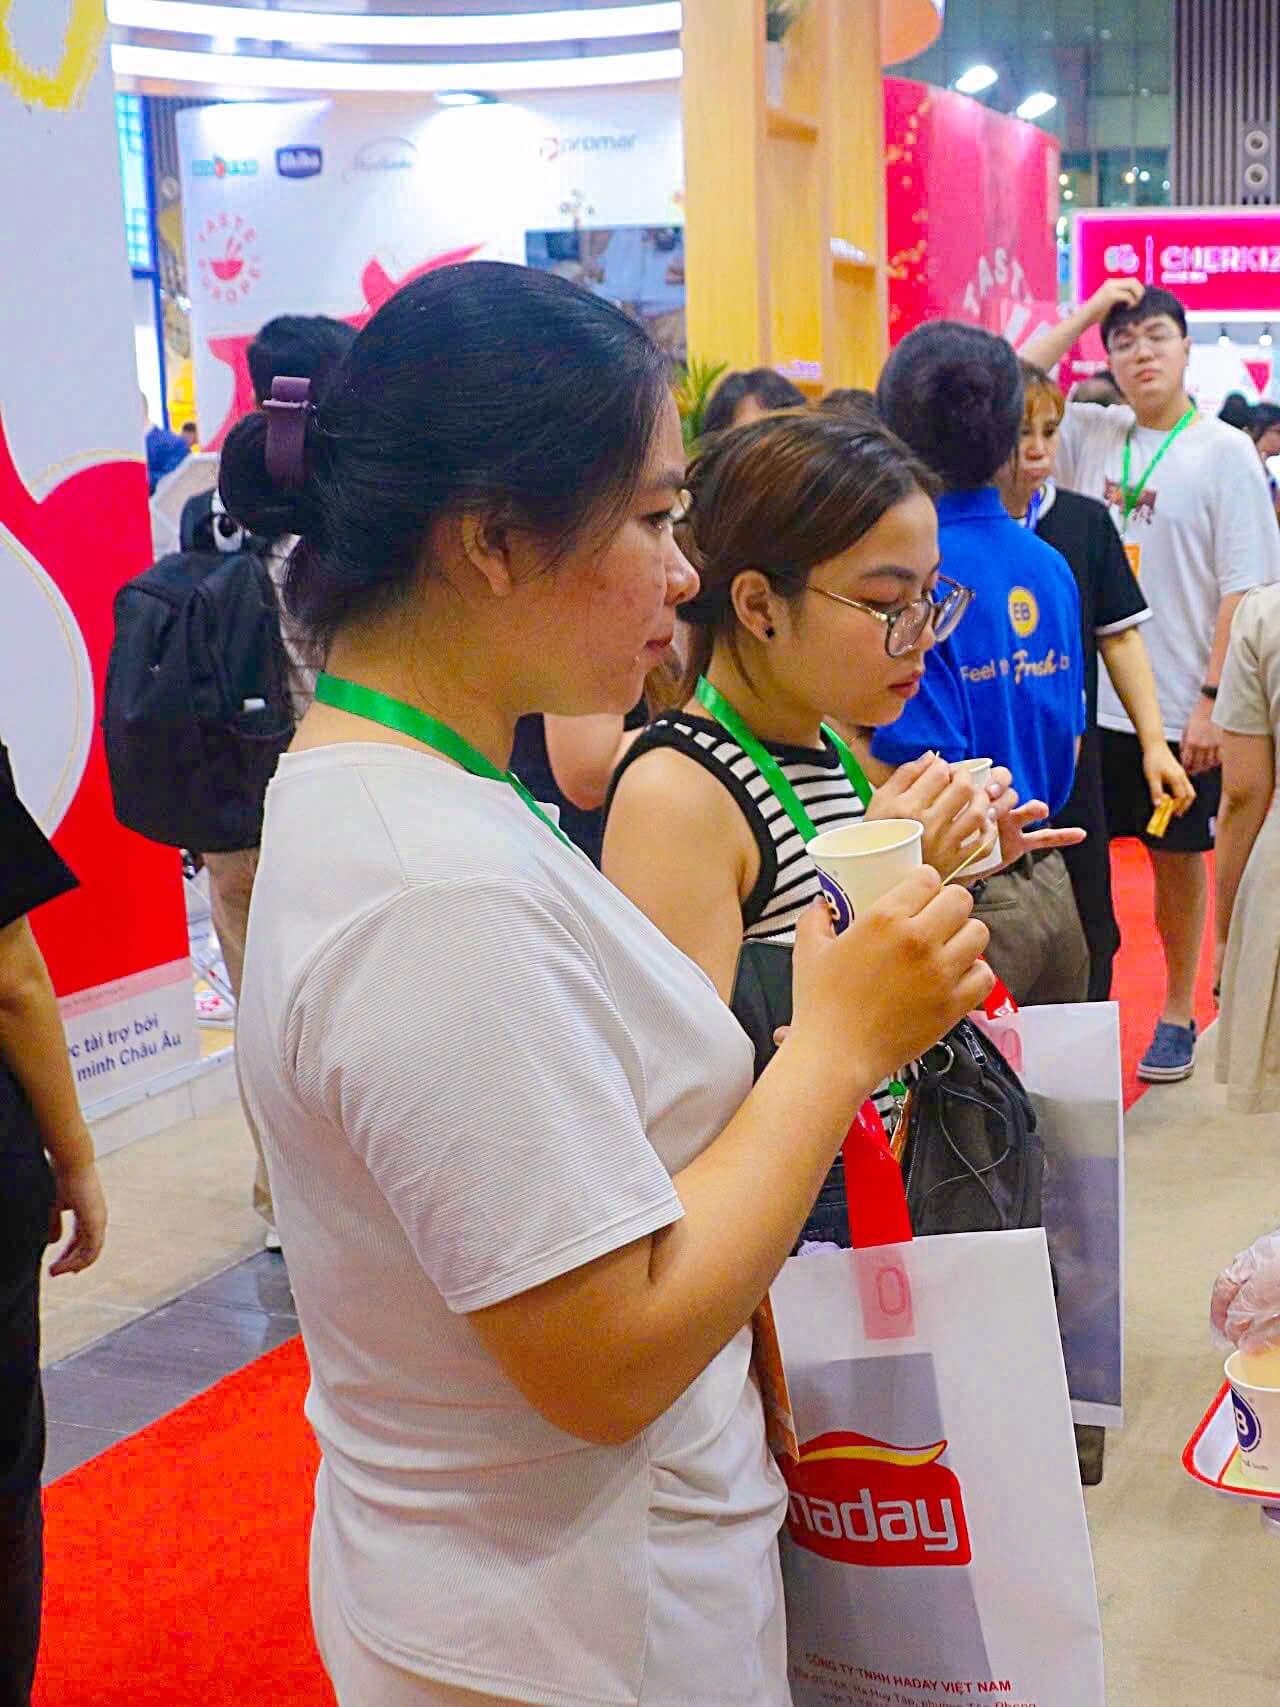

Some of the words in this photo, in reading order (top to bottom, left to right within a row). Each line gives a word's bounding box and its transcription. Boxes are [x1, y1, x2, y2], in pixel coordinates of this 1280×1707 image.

[1014, 602, 1031, 621] EB
[960, 658, 996, 682] Feel
[76, 1055, 116, 1082] minh
[119, 1043, 158, 1066] Châu
[893, 1675, 937, 1692] HADAY
[976, 1679, 1012, 1694] NAM
